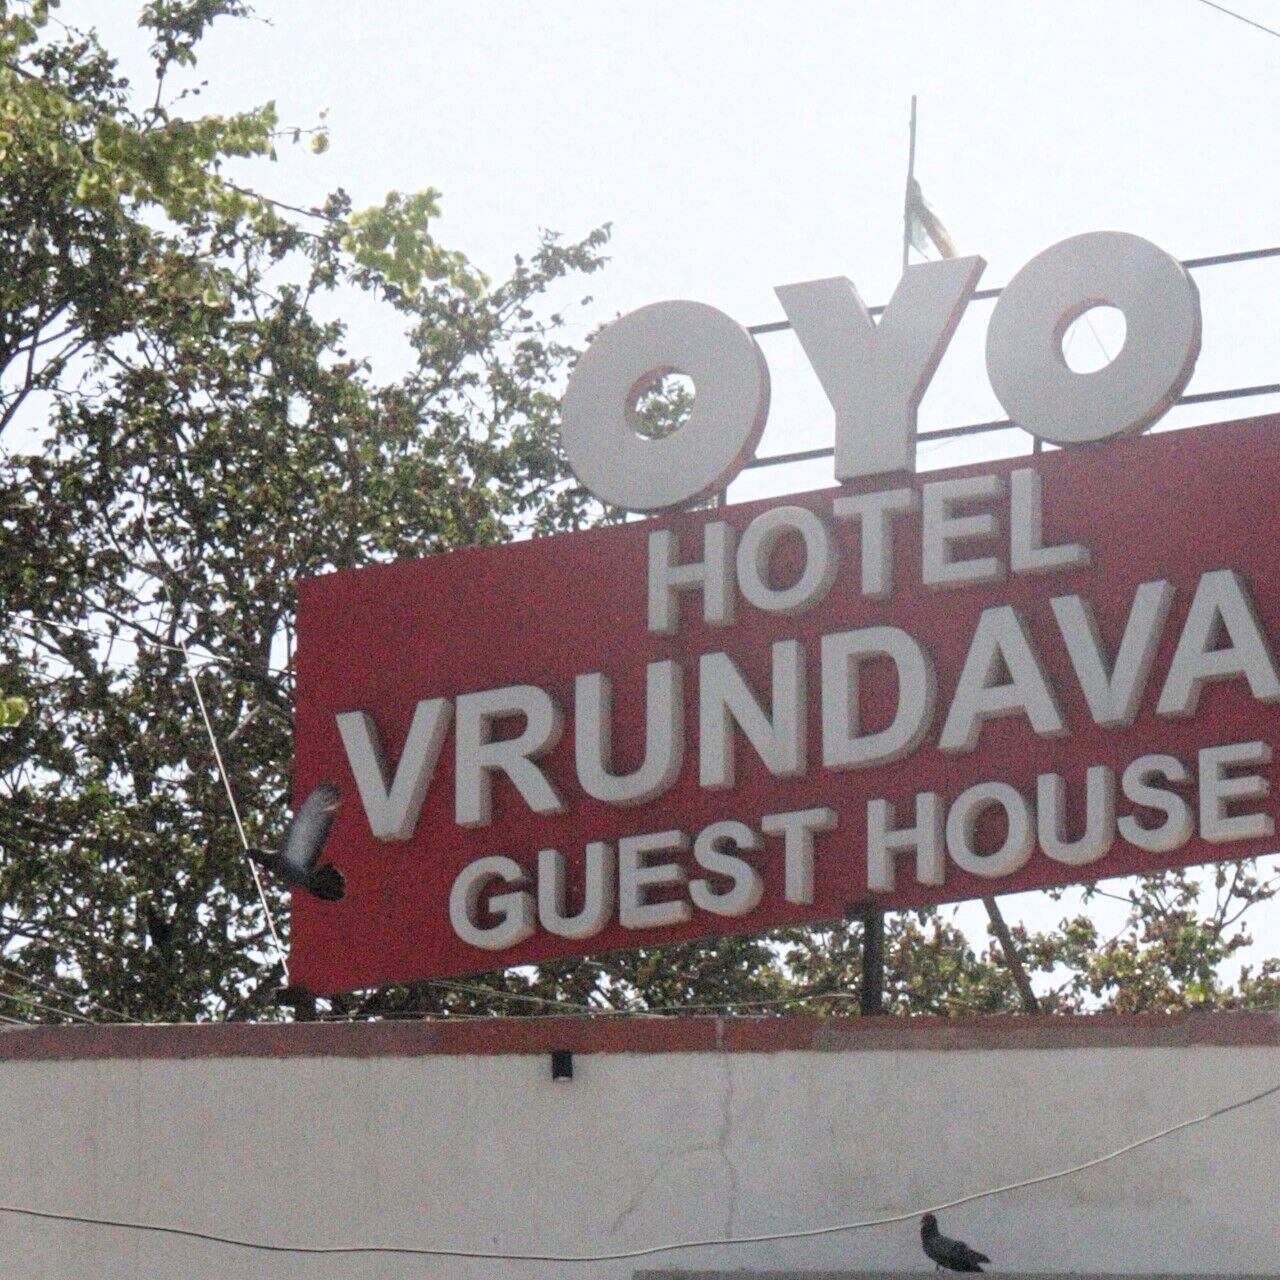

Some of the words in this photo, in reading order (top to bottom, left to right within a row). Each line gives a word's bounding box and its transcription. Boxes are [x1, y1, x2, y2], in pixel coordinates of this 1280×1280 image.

[561, 231, 1201, 513] OYO
[647, 467, 1090, 635] HOTEL
[449, 806, 837, 950] GUEST
[866, 740, 1275, 891] HOUSE
